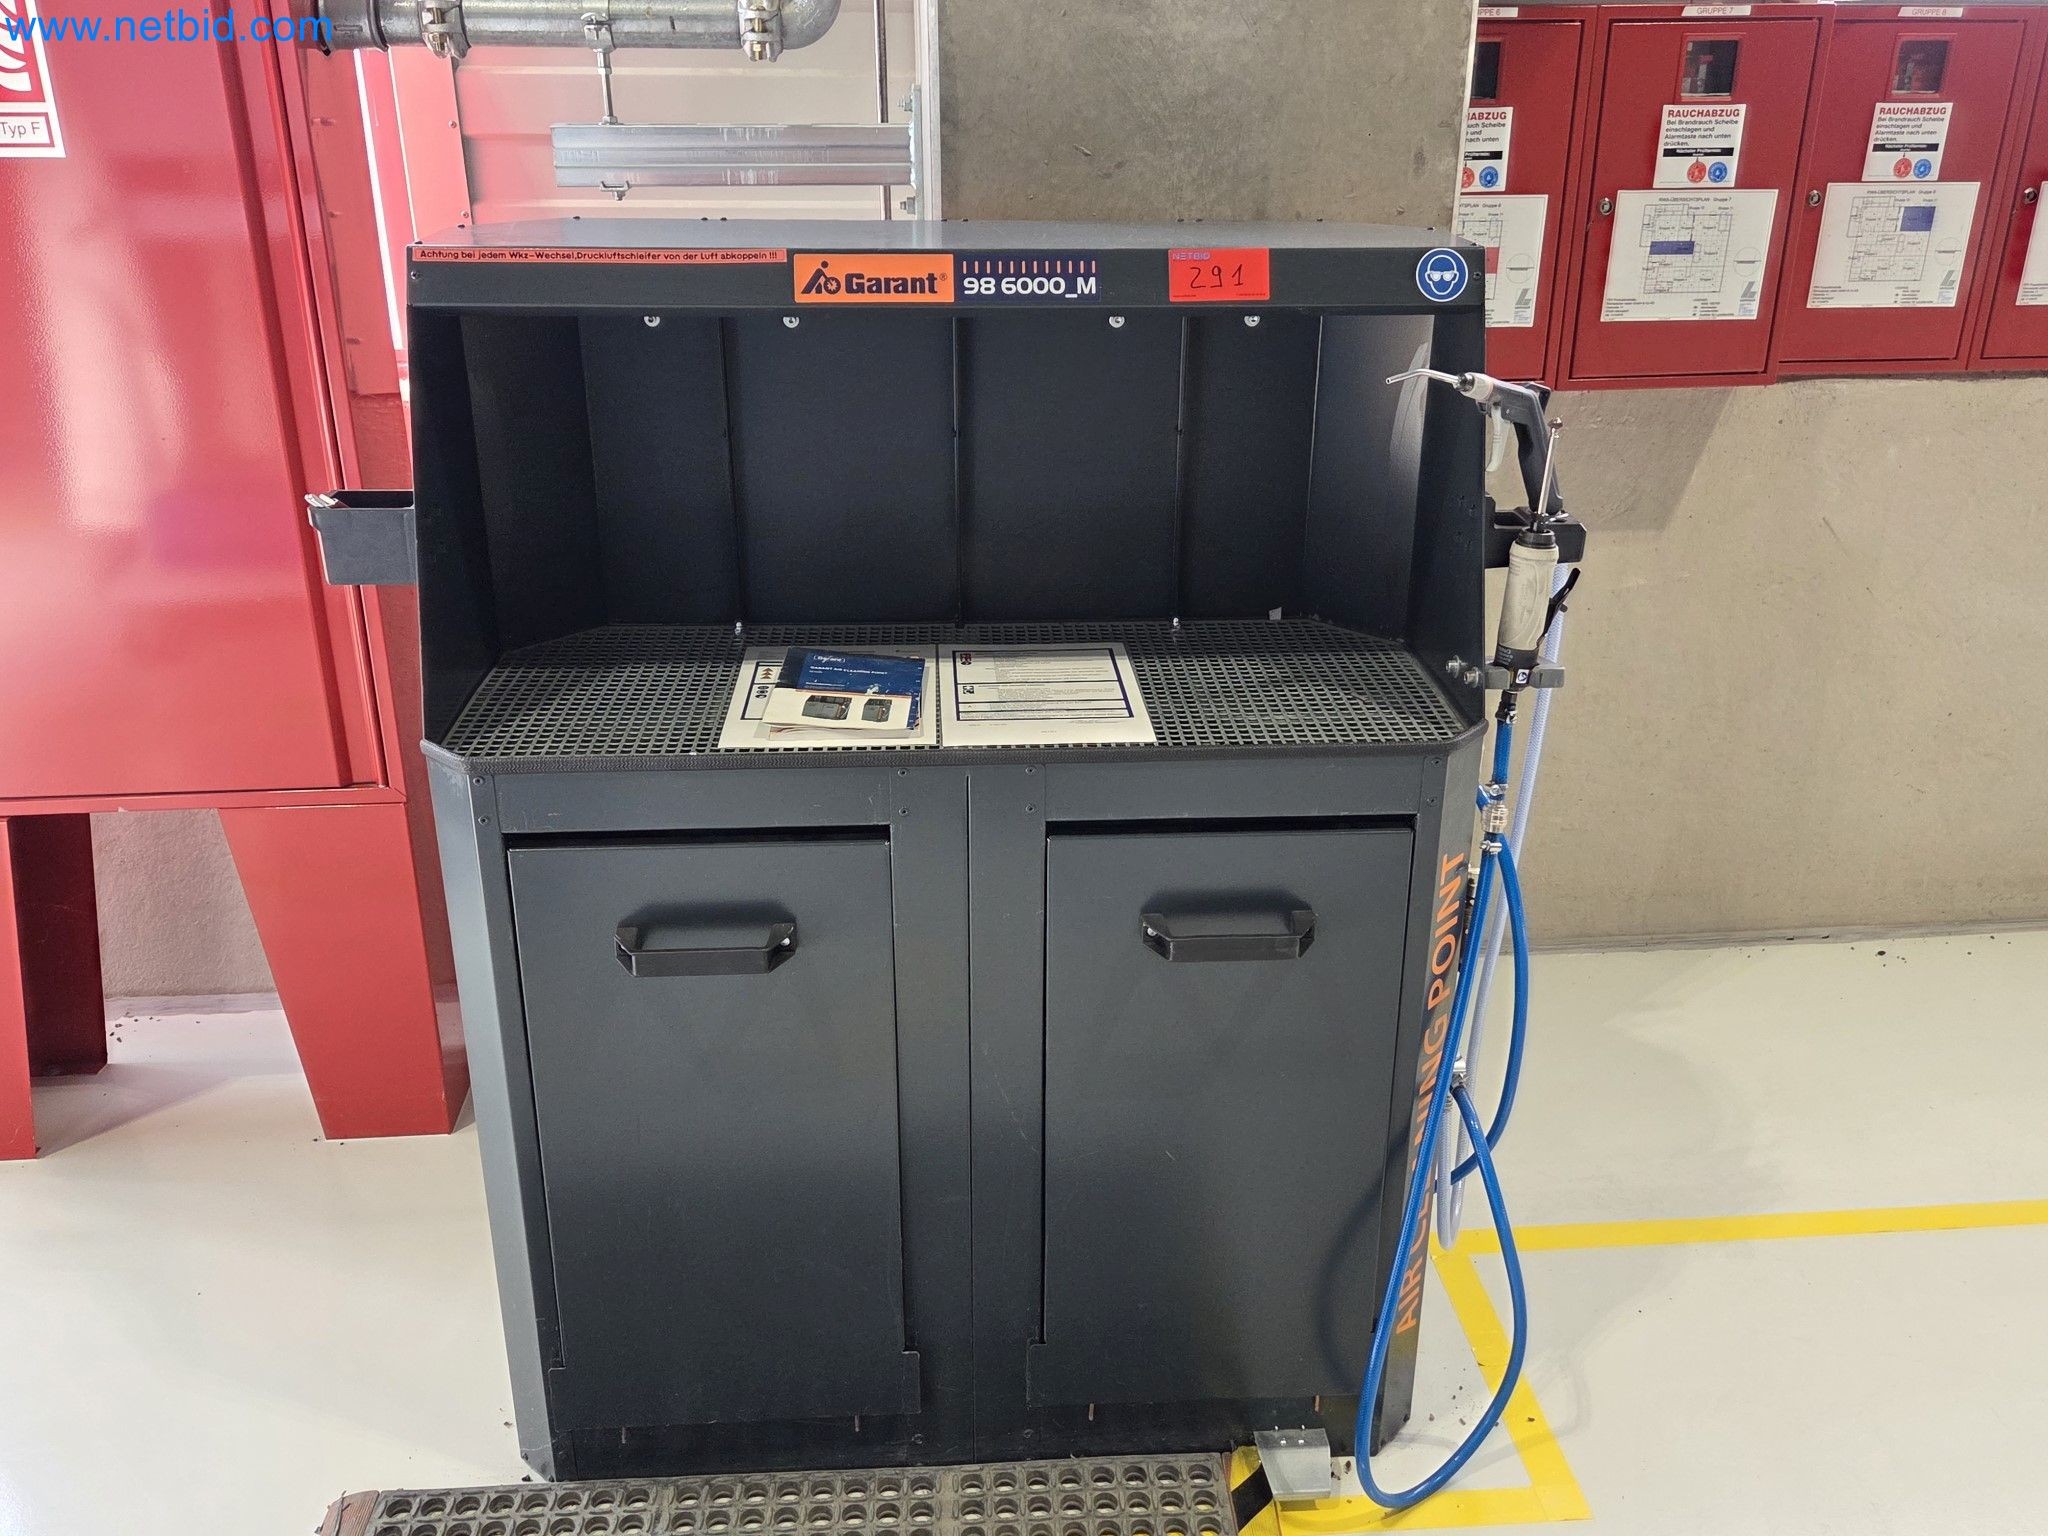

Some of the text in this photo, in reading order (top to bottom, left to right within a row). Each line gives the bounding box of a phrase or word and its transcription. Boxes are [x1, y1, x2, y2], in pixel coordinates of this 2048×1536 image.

[1495, 8, 1501, 16] 6
[1697, 7, 1727, 15] GRUPPE
[1912, 8, 1940, 16] GRUPPE
[1667, 108, 1741, 119] RAUCHABZUG
[1879, 106, 1947, 116] RAUCHABZUG
[0, 121, 41, 136] Typ F
[1481, 121, 1507, 129] Scheibe
[420, 250, 458, 261] Achtung
[460, 250, 476, 259] bei
[477, 250, 507, 260] jedem
[683, 252, 699, 261] der
[700, 251, 719, 261] Luft
[720, 252, 767, 261] abkoppeln
[769, 251, 778, 260] !!!
[1172, 251, 1211, 261] NETBID
[1189, 263, 1245, 289] 291
[962, 276, 997, 296] 98
[1000, 276, 1097, 299] 6000_M
[1396, 1256, 1423, 1335] AIR
[1427, 852, 1465, 1011] POINT
